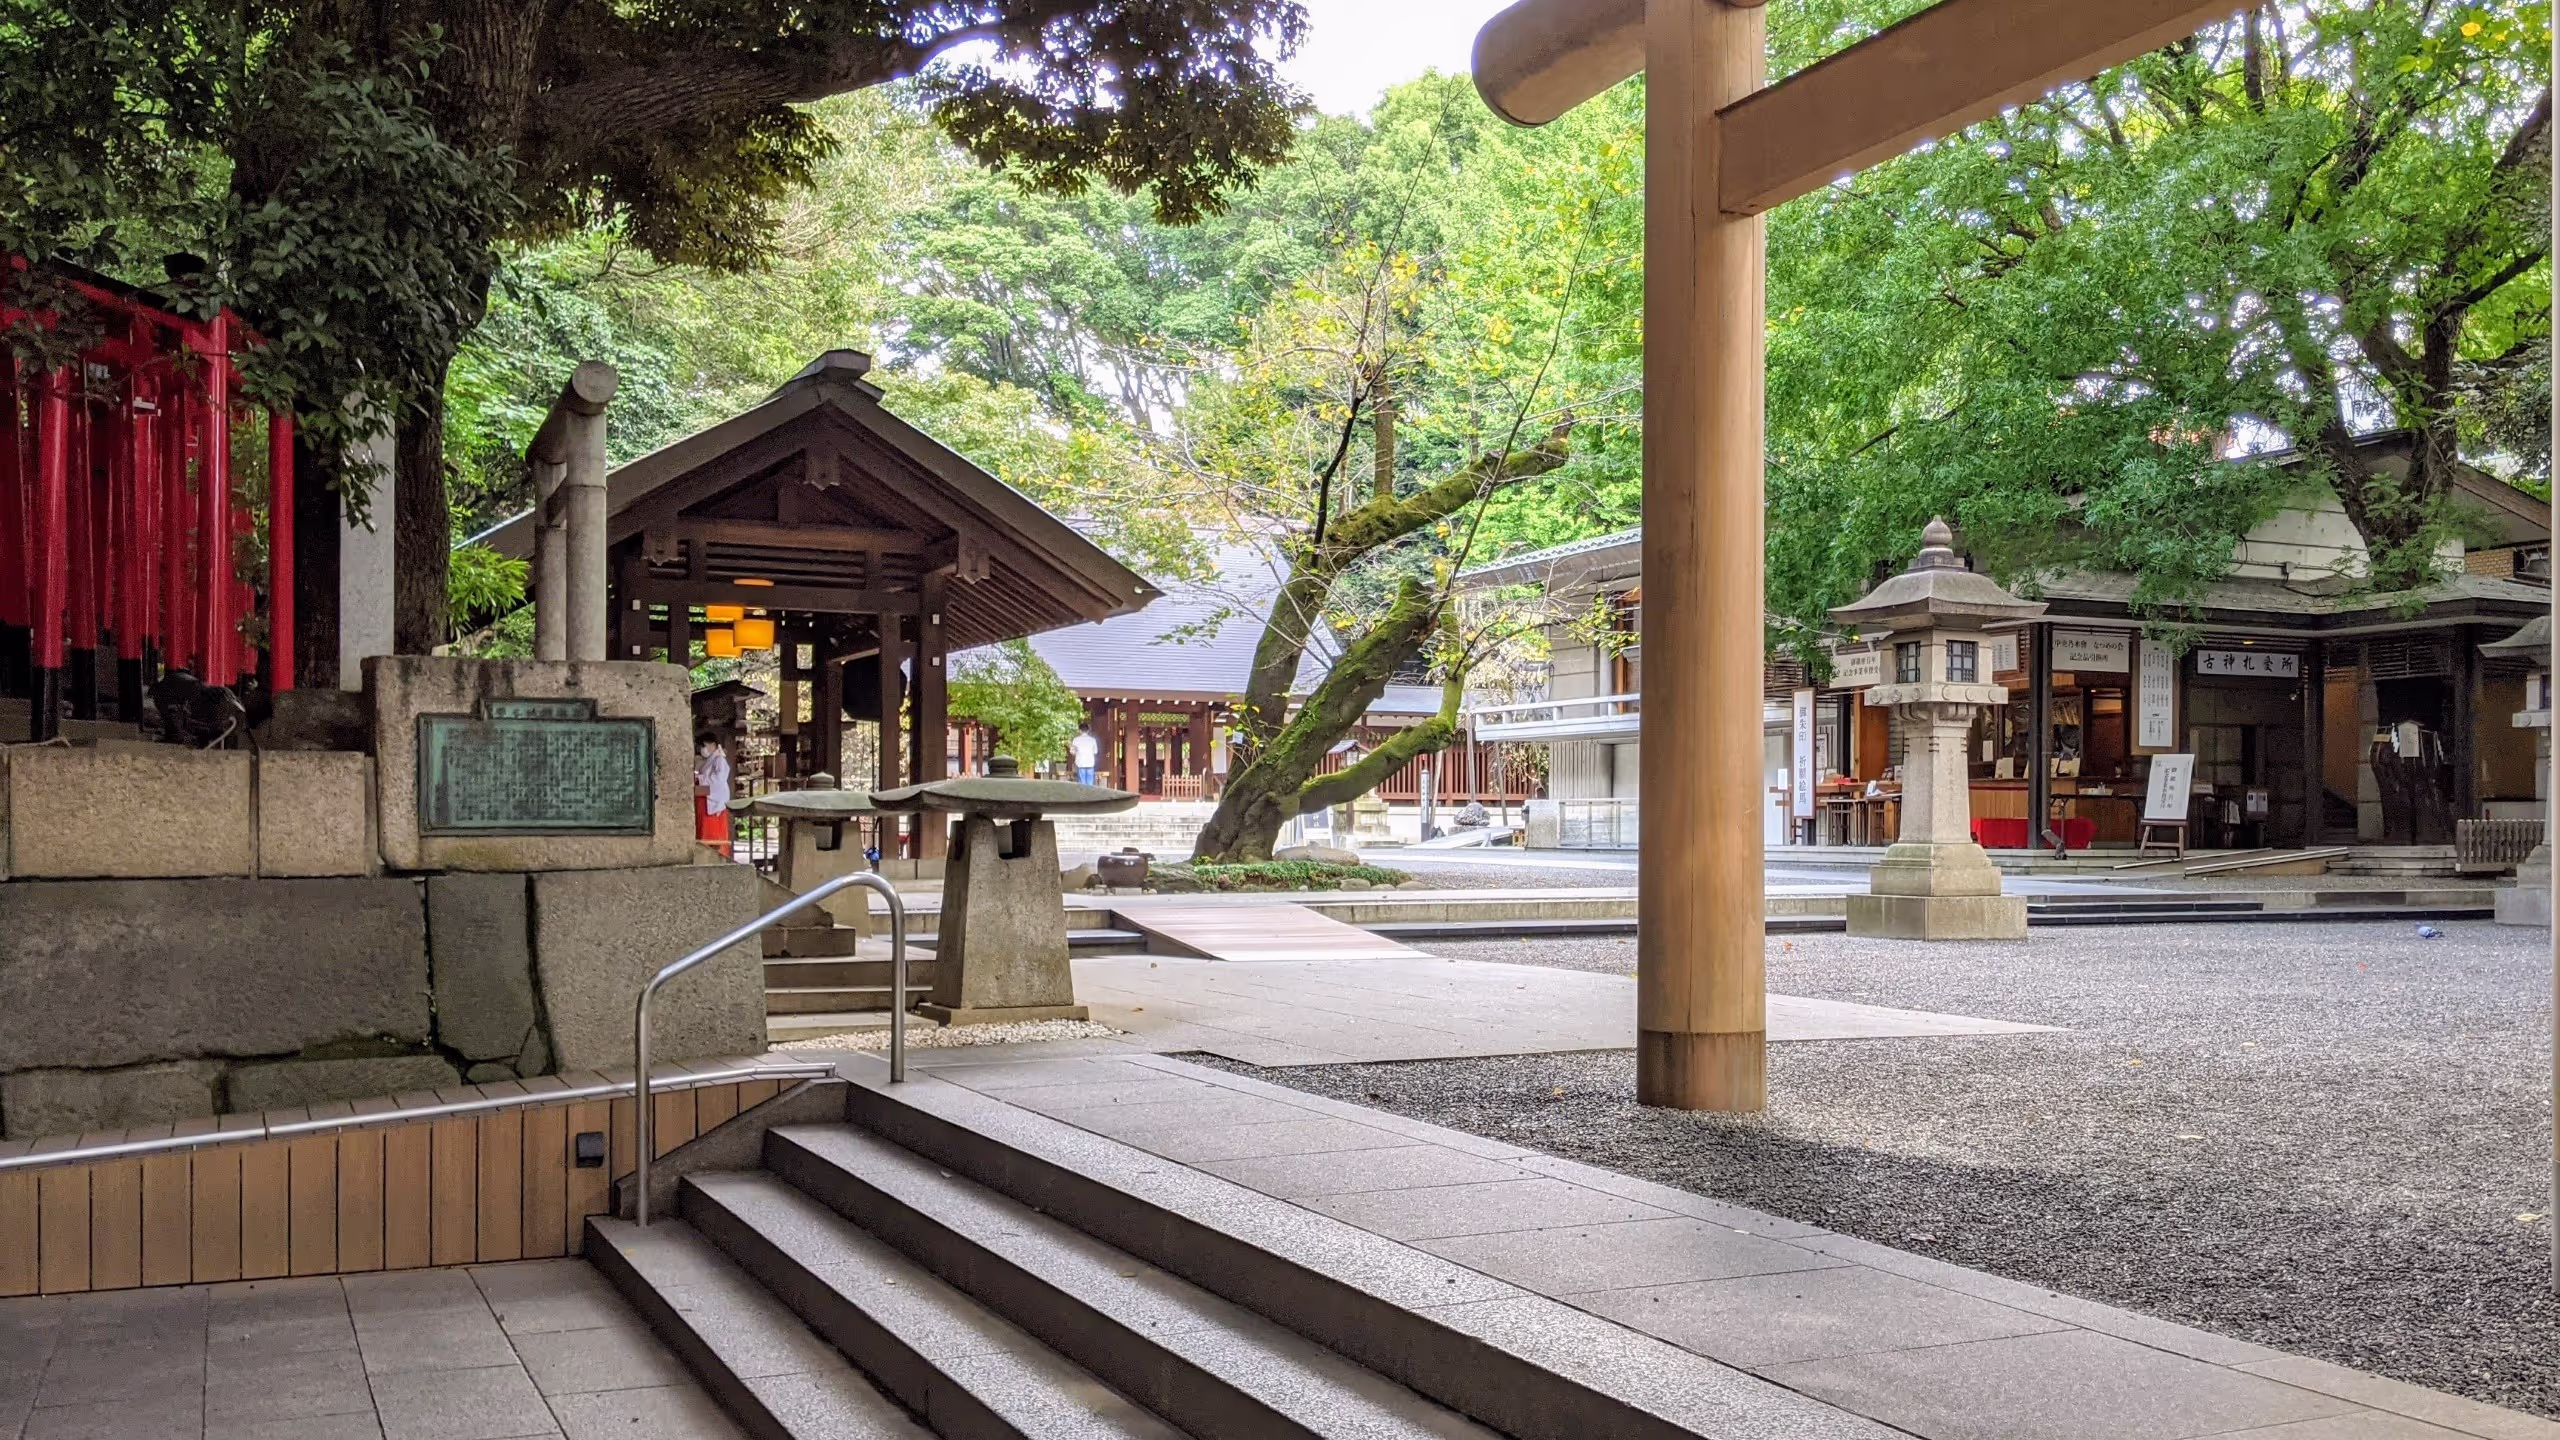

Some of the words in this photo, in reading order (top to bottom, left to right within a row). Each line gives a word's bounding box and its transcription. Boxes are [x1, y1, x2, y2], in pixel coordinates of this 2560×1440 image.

[2203, 653, 2293, 673] 古神札受所
